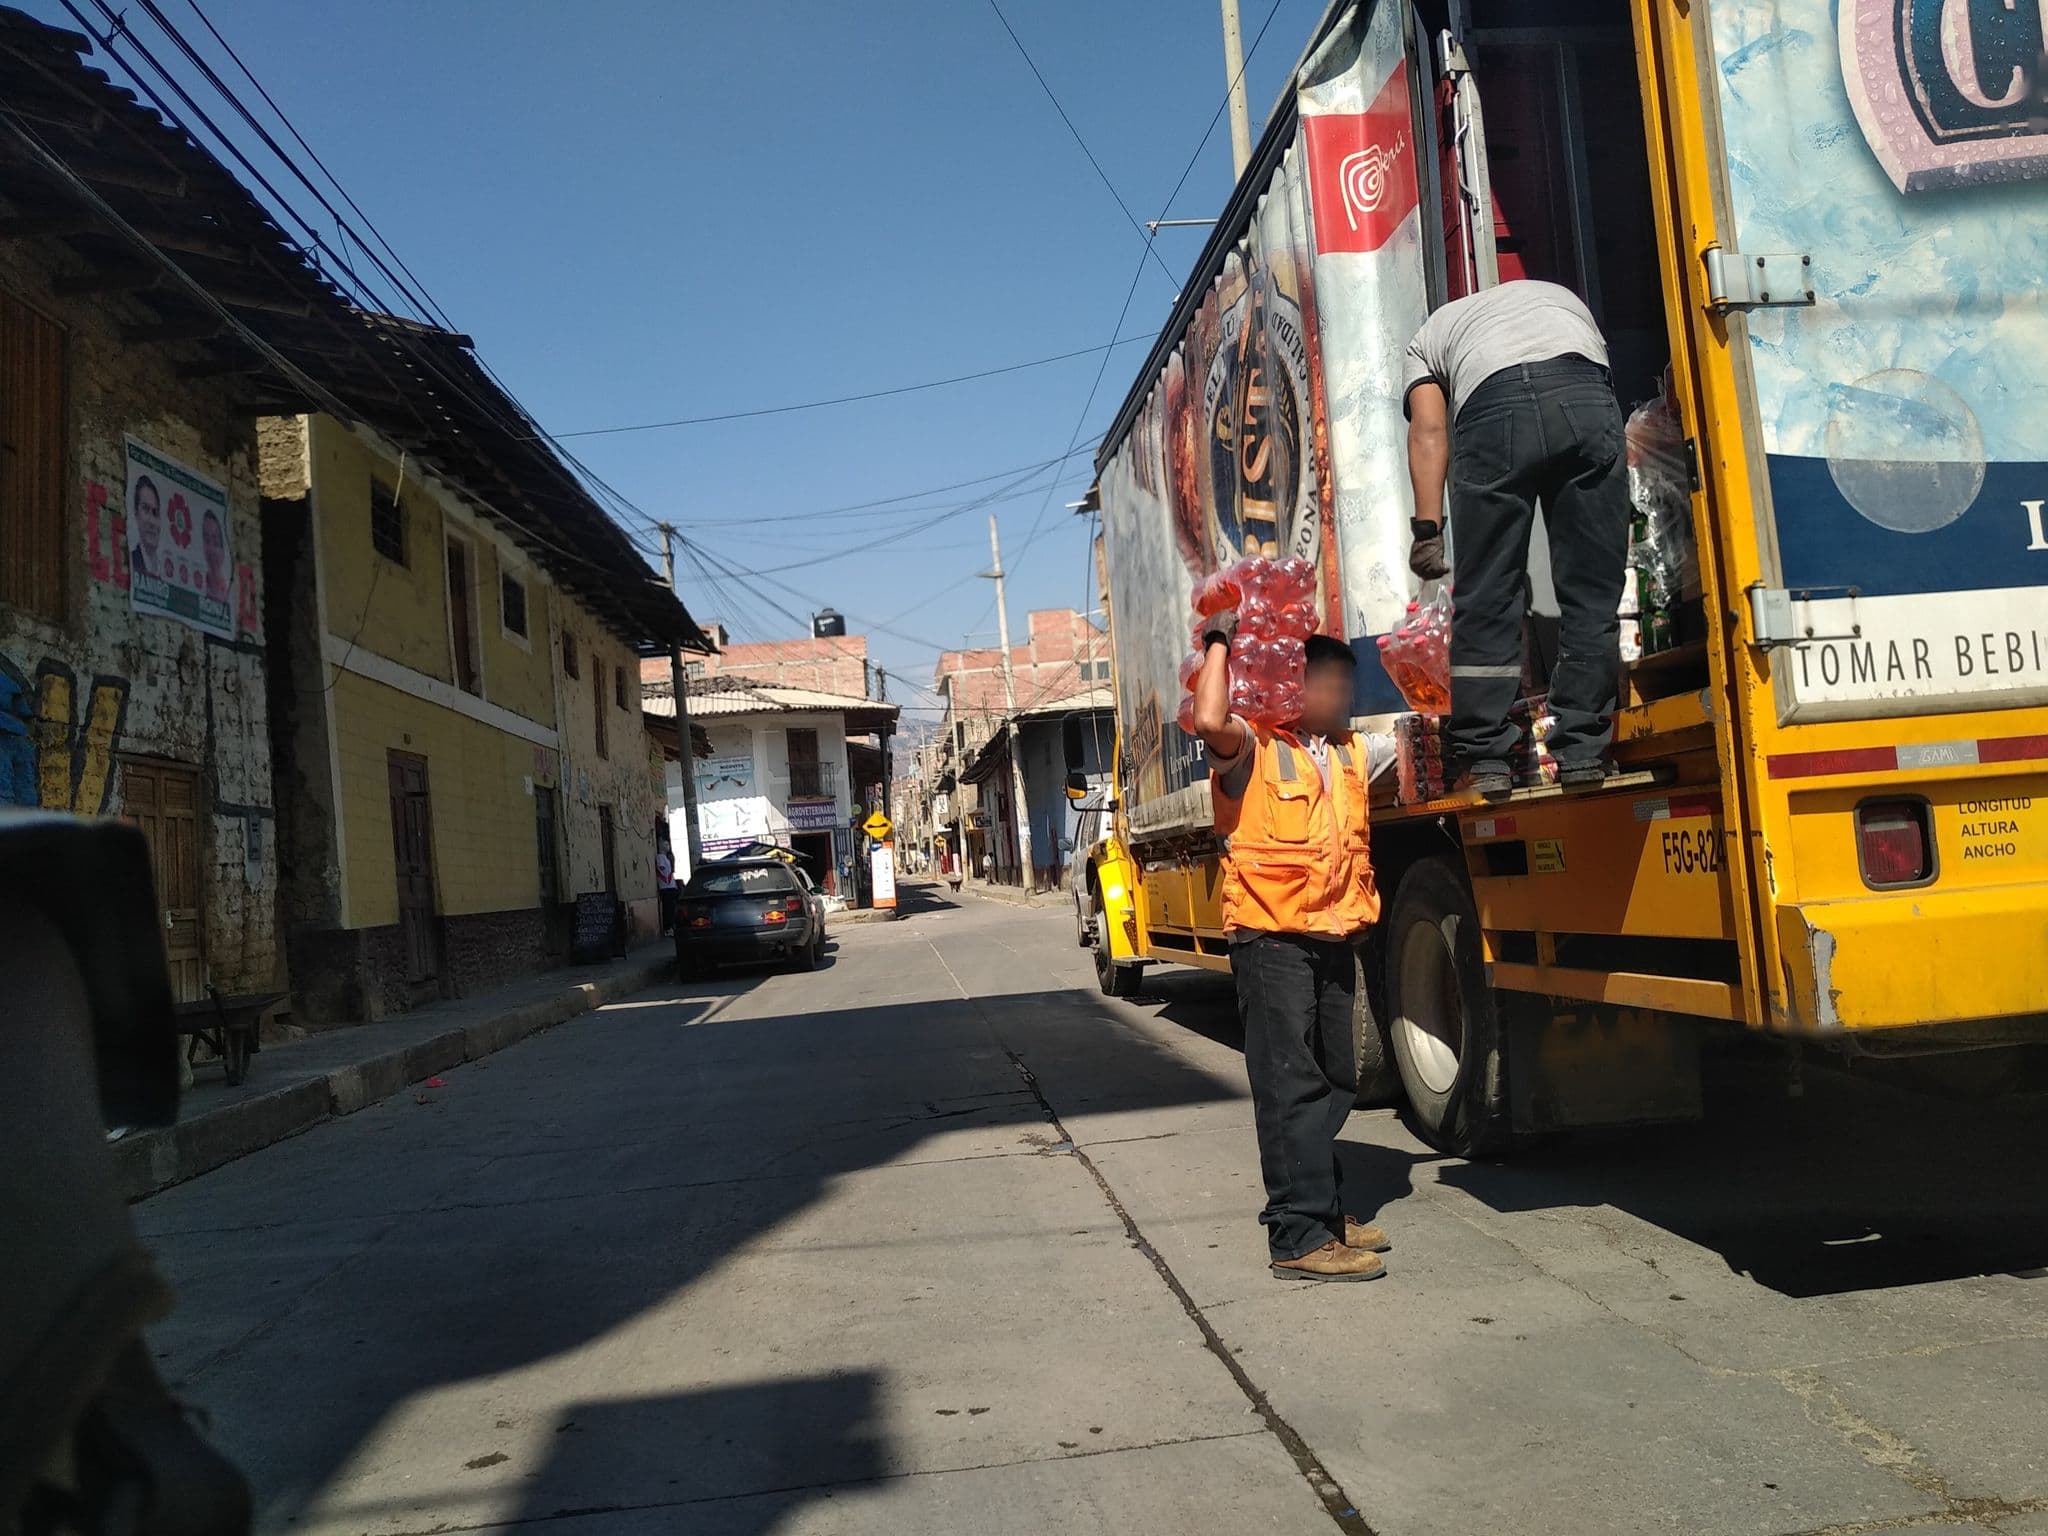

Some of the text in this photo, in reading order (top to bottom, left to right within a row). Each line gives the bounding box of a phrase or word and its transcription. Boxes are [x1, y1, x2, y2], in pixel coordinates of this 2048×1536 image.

[1795, 630, 2048, 687] TOMAR BEBI
[1958, 796, 2032, 815] LONGITUD
[1961, 820, 2020, 838] ALTURA
[1662, 826, 1728, 875] F5G-824
[1963, 842, 2017, 860] ANCHO
